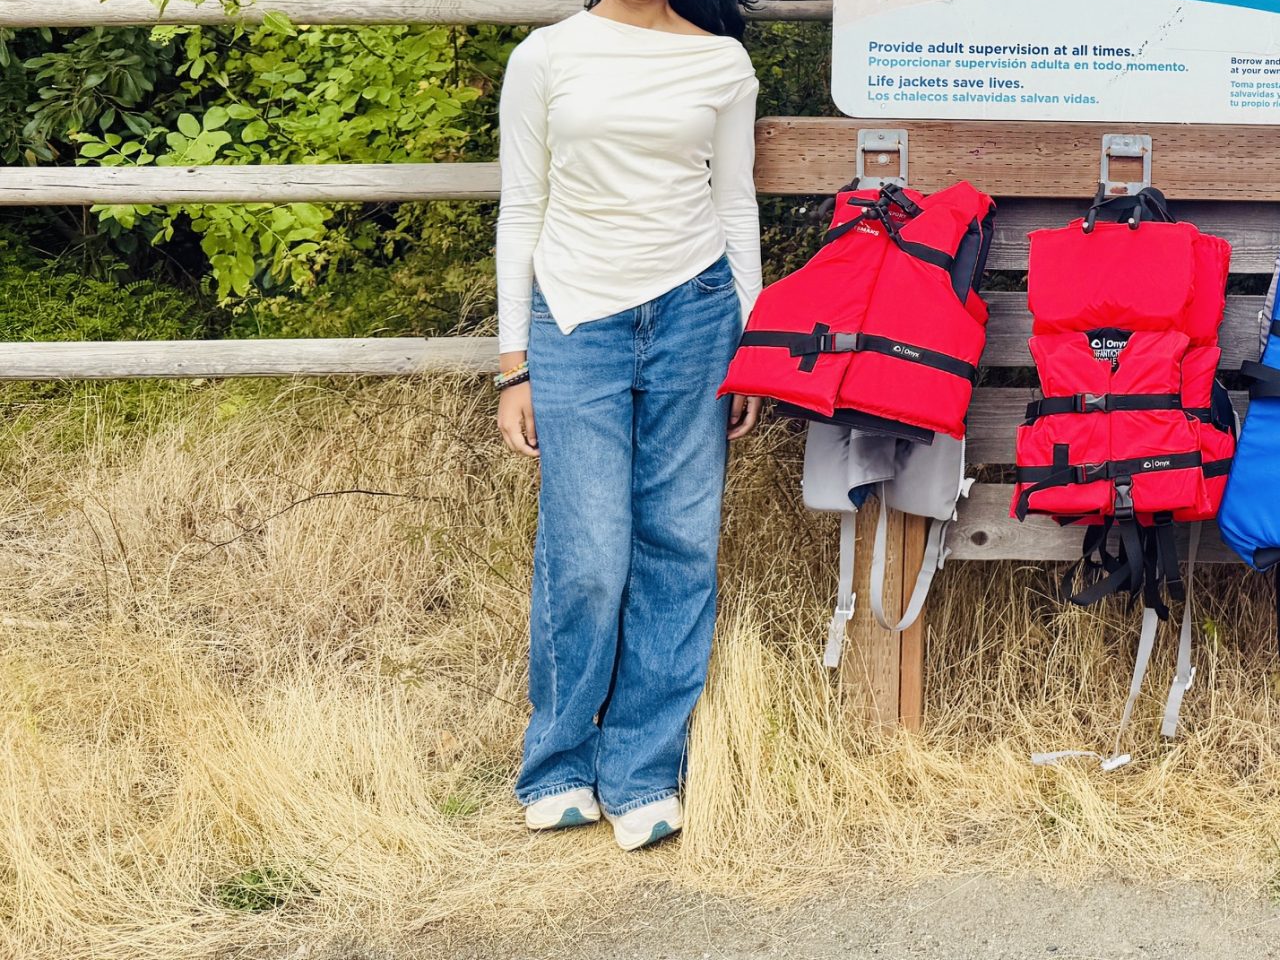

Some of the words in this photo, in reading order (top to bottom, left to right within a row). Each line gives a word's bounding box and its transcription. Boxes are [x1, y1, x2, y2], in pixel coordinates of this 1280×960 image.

[869, 41, 923, 53] Provide
[927, 42, 964, 54] adult
[968, 43, 1050, 57] supervision
[1054, 45, 1067, 55] at
[1072, 45, 1088, 56] all
[1092, 45, 1135, 57] times.
[868, 57, 951, 70] Proporcionar
[955, 58, 1027, 71] supervisión
[1030, 59, 1070, 70] adulta
[1074, 62, 1089, 70] en
[1093, 60, 1122, 71] todo
[1127, 62, 1189, 72] momento.
[1231, 57, 1262, 65] Borrow
[868, 76, 894, 87] Life
[898, 76, 948, 89] jackets
[953, 78, 984, 88] save
[989, 77, 1024, 89] lives.
[868, 91, 889, 101] Los
[894, 90, 948, 102] chalecos
[952, 91, 1016, 103] salvavidas
[1020, 93, 1059, 104] salvan
[1063, 93, 1099, 104] vidas.
[905, 349, 920, 358] Onyx
